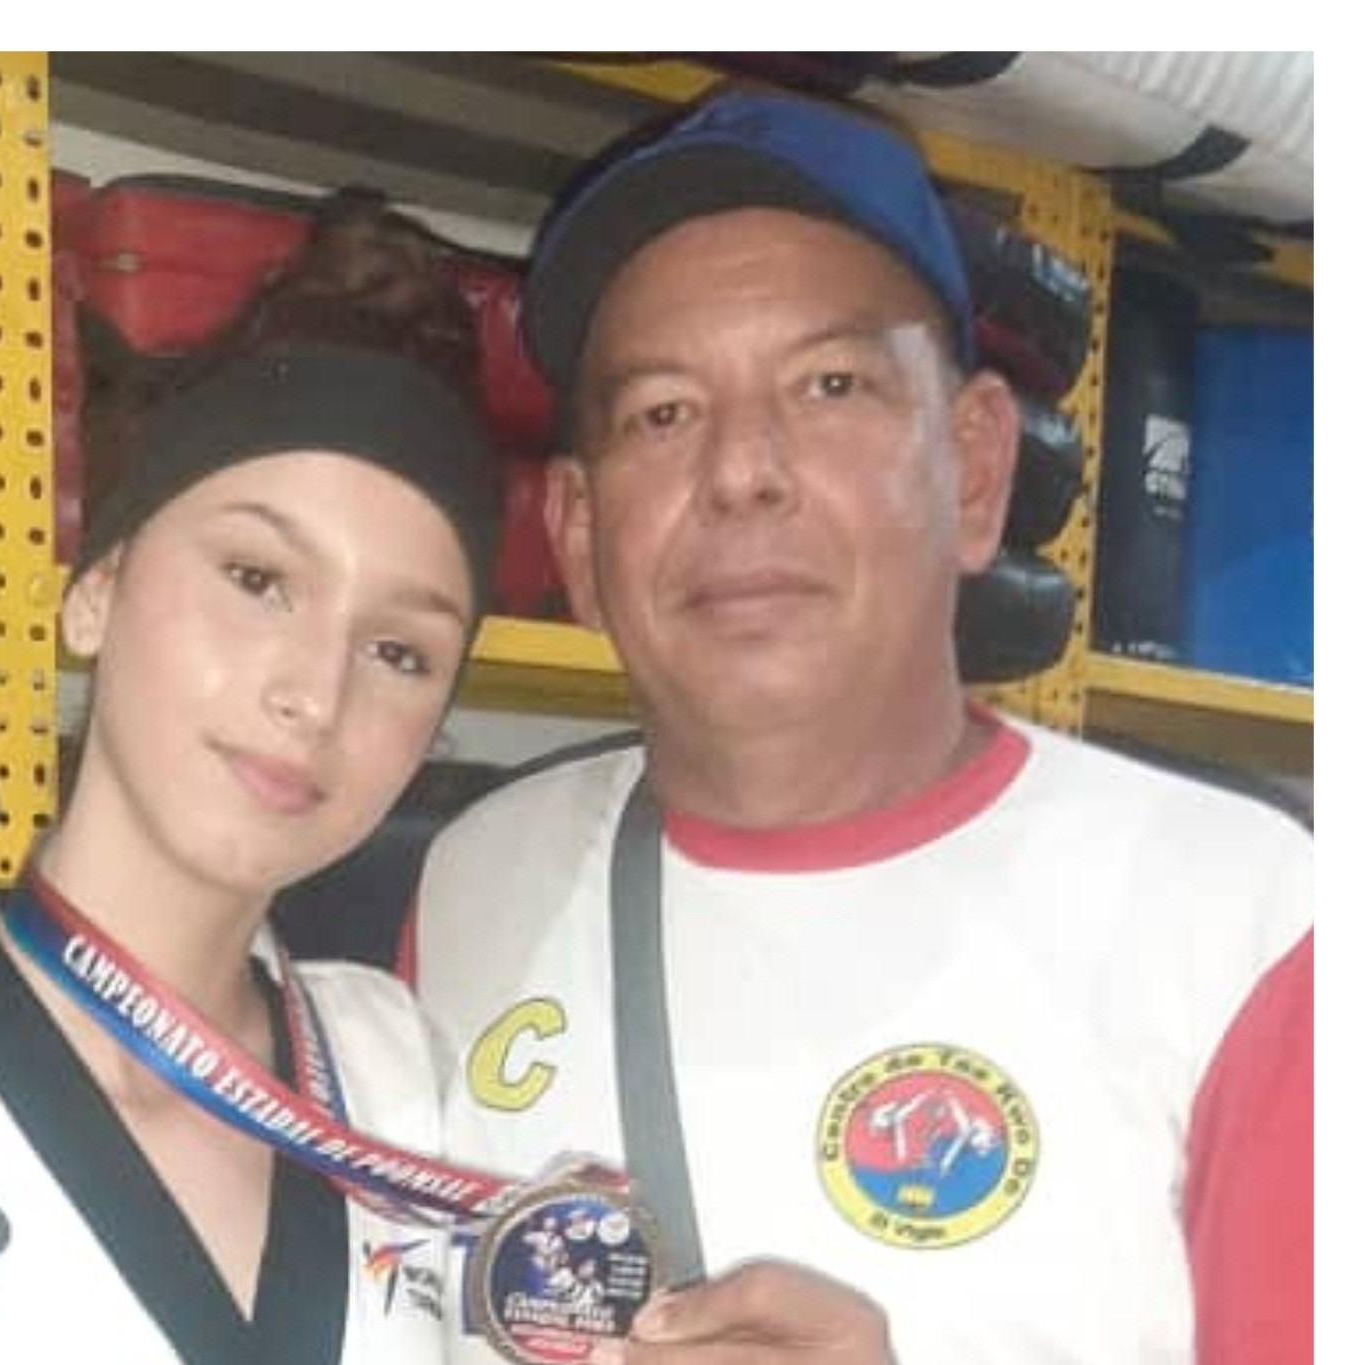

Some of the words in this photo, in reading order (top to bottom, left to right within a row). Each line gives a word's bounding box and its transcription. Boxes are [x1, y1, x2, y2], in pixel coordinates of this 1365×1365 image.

[61, 933, 221, 1080] CAMPEONATO
[213, 1065, 321, 1148] ESTADAL
[466, 997, 567, 1112] C
